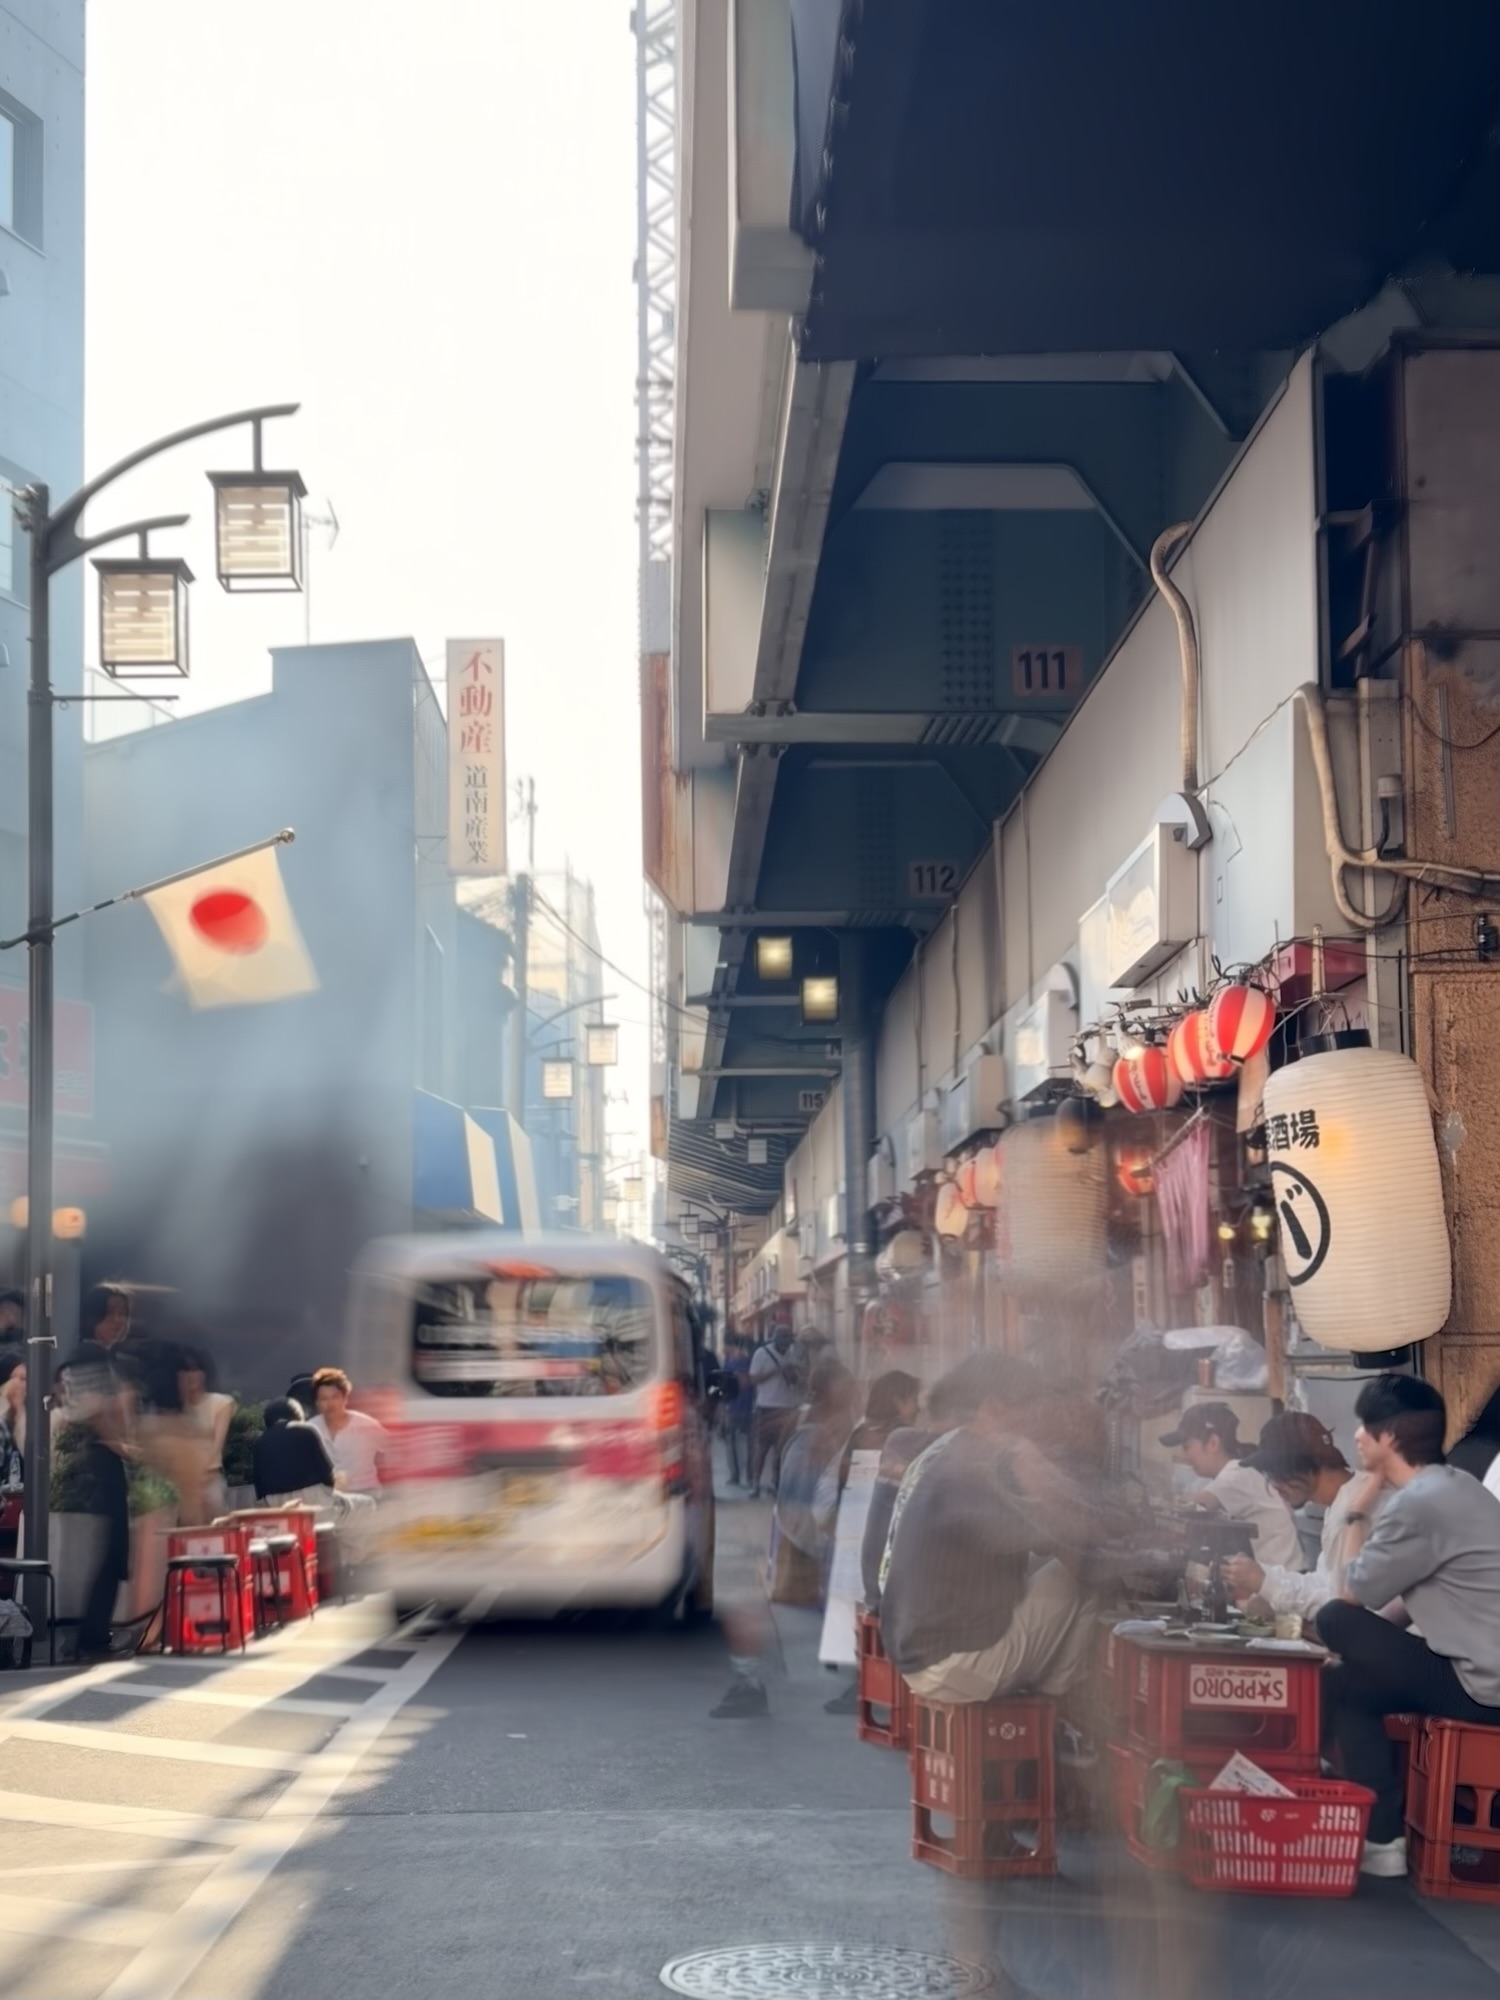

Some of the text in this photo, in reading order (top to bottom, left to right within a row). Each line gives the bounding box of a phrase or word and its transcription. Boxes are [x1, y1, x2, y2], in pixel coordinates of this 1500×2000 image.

[460, 648, 492, 754] 不動産
[1018, 651, 1065, 690] 111
[465, 764, 488, 865] 道南産業
[914, 865, 955, 893] 112
